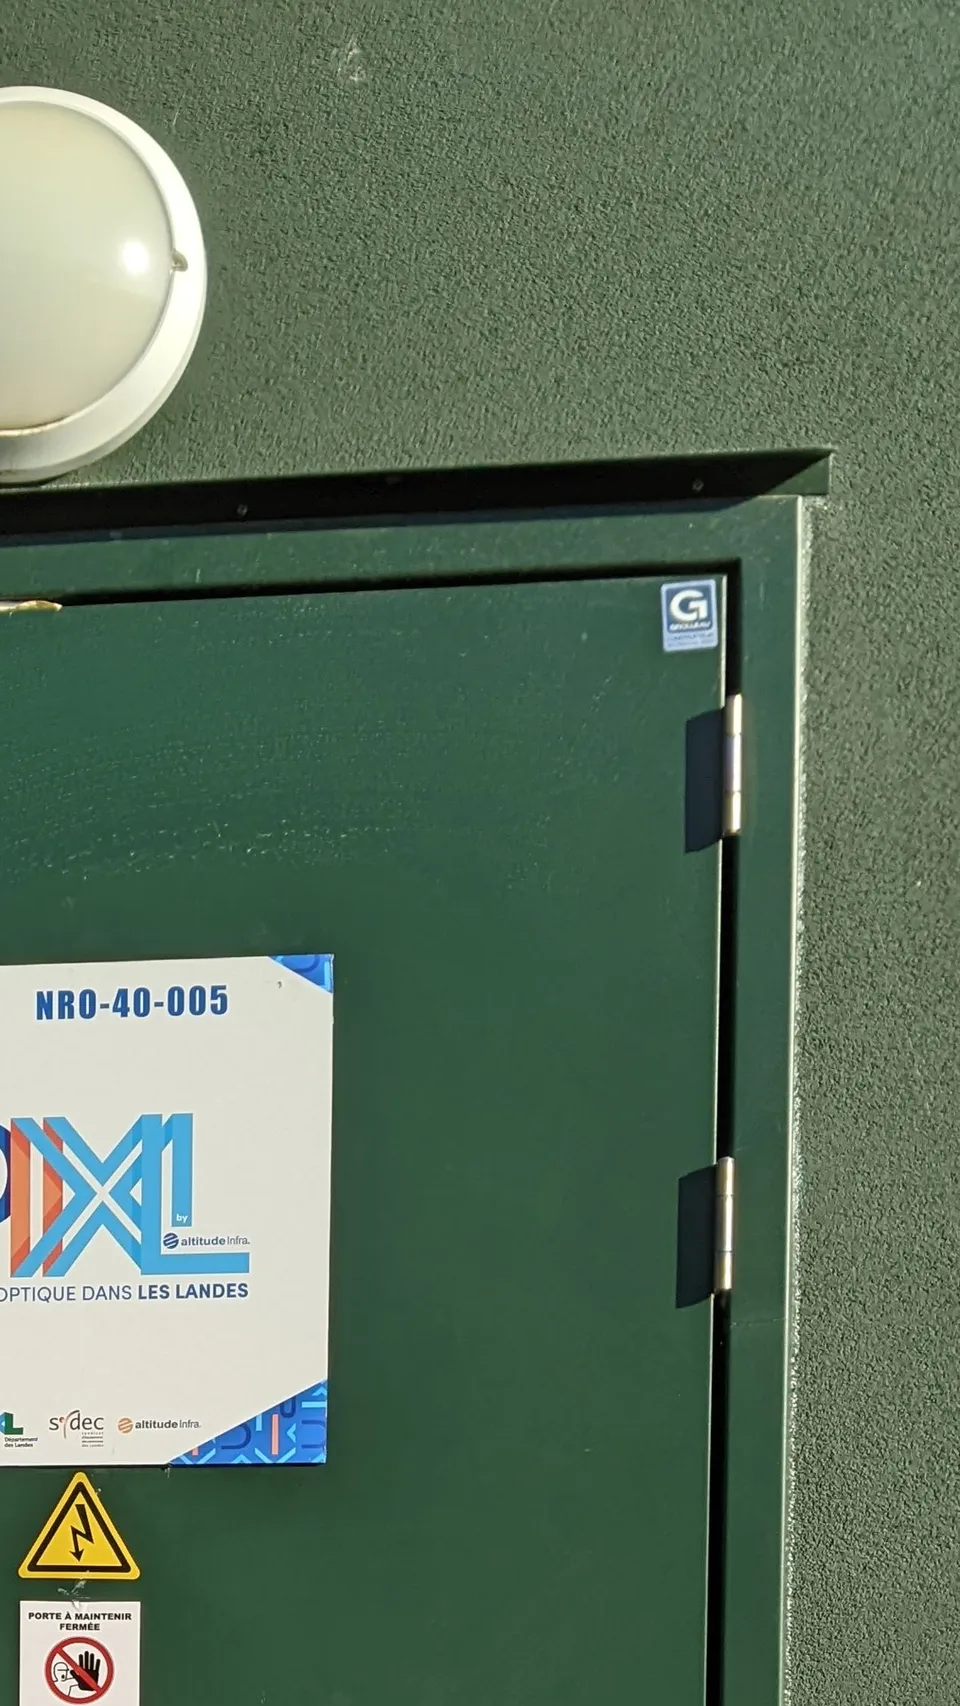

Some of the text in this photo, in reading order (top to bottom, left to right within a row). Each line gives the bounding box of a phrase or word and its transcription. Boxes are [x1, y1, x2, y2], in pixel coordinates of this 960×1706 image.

[36, 984, 227, 1020] NRO-40-005
[176, 1214, 188, 1223] by
[180, 1236, 225, 1246] altitude
[82, 1284, 132, 1300] DANS
[138, 1284, 170, 1299] LES
[175, 1282, 248, 1299] LANDES
[135, 1419, 178, 1429] altitude
[28, 1611, 131, 1621] PORTE À MAINTENIR
[59, 1622, 100, 1630] FERMÉE
